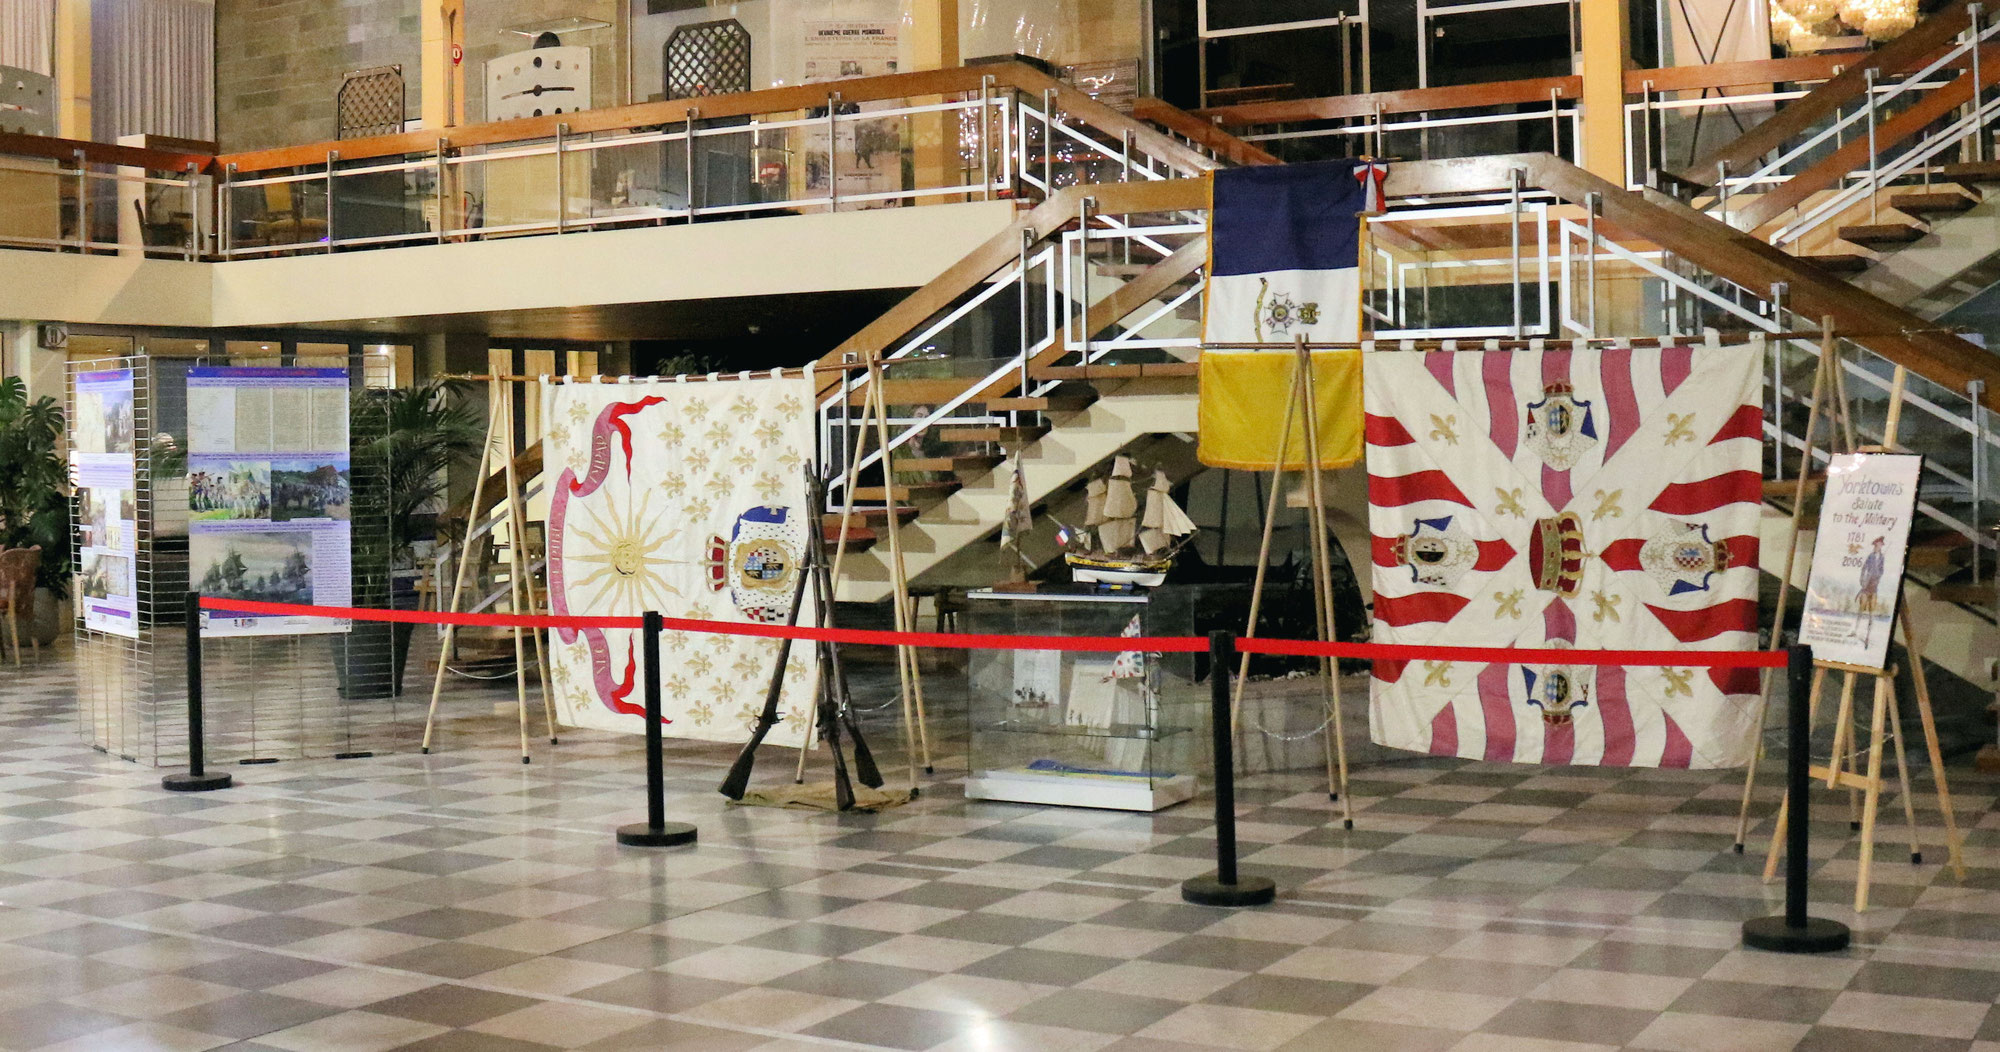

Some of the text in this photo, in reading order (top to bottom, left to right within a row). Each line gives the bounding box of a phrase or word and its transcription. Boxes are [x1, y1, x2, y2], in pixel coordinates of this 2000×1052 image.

[1851, 497, 1884, 510] Salute
[1833, 512, 1898, 531] to the Military
[1847, 532, 1866, 543] 1781
[1842, 556, 1863, 567] 2006
